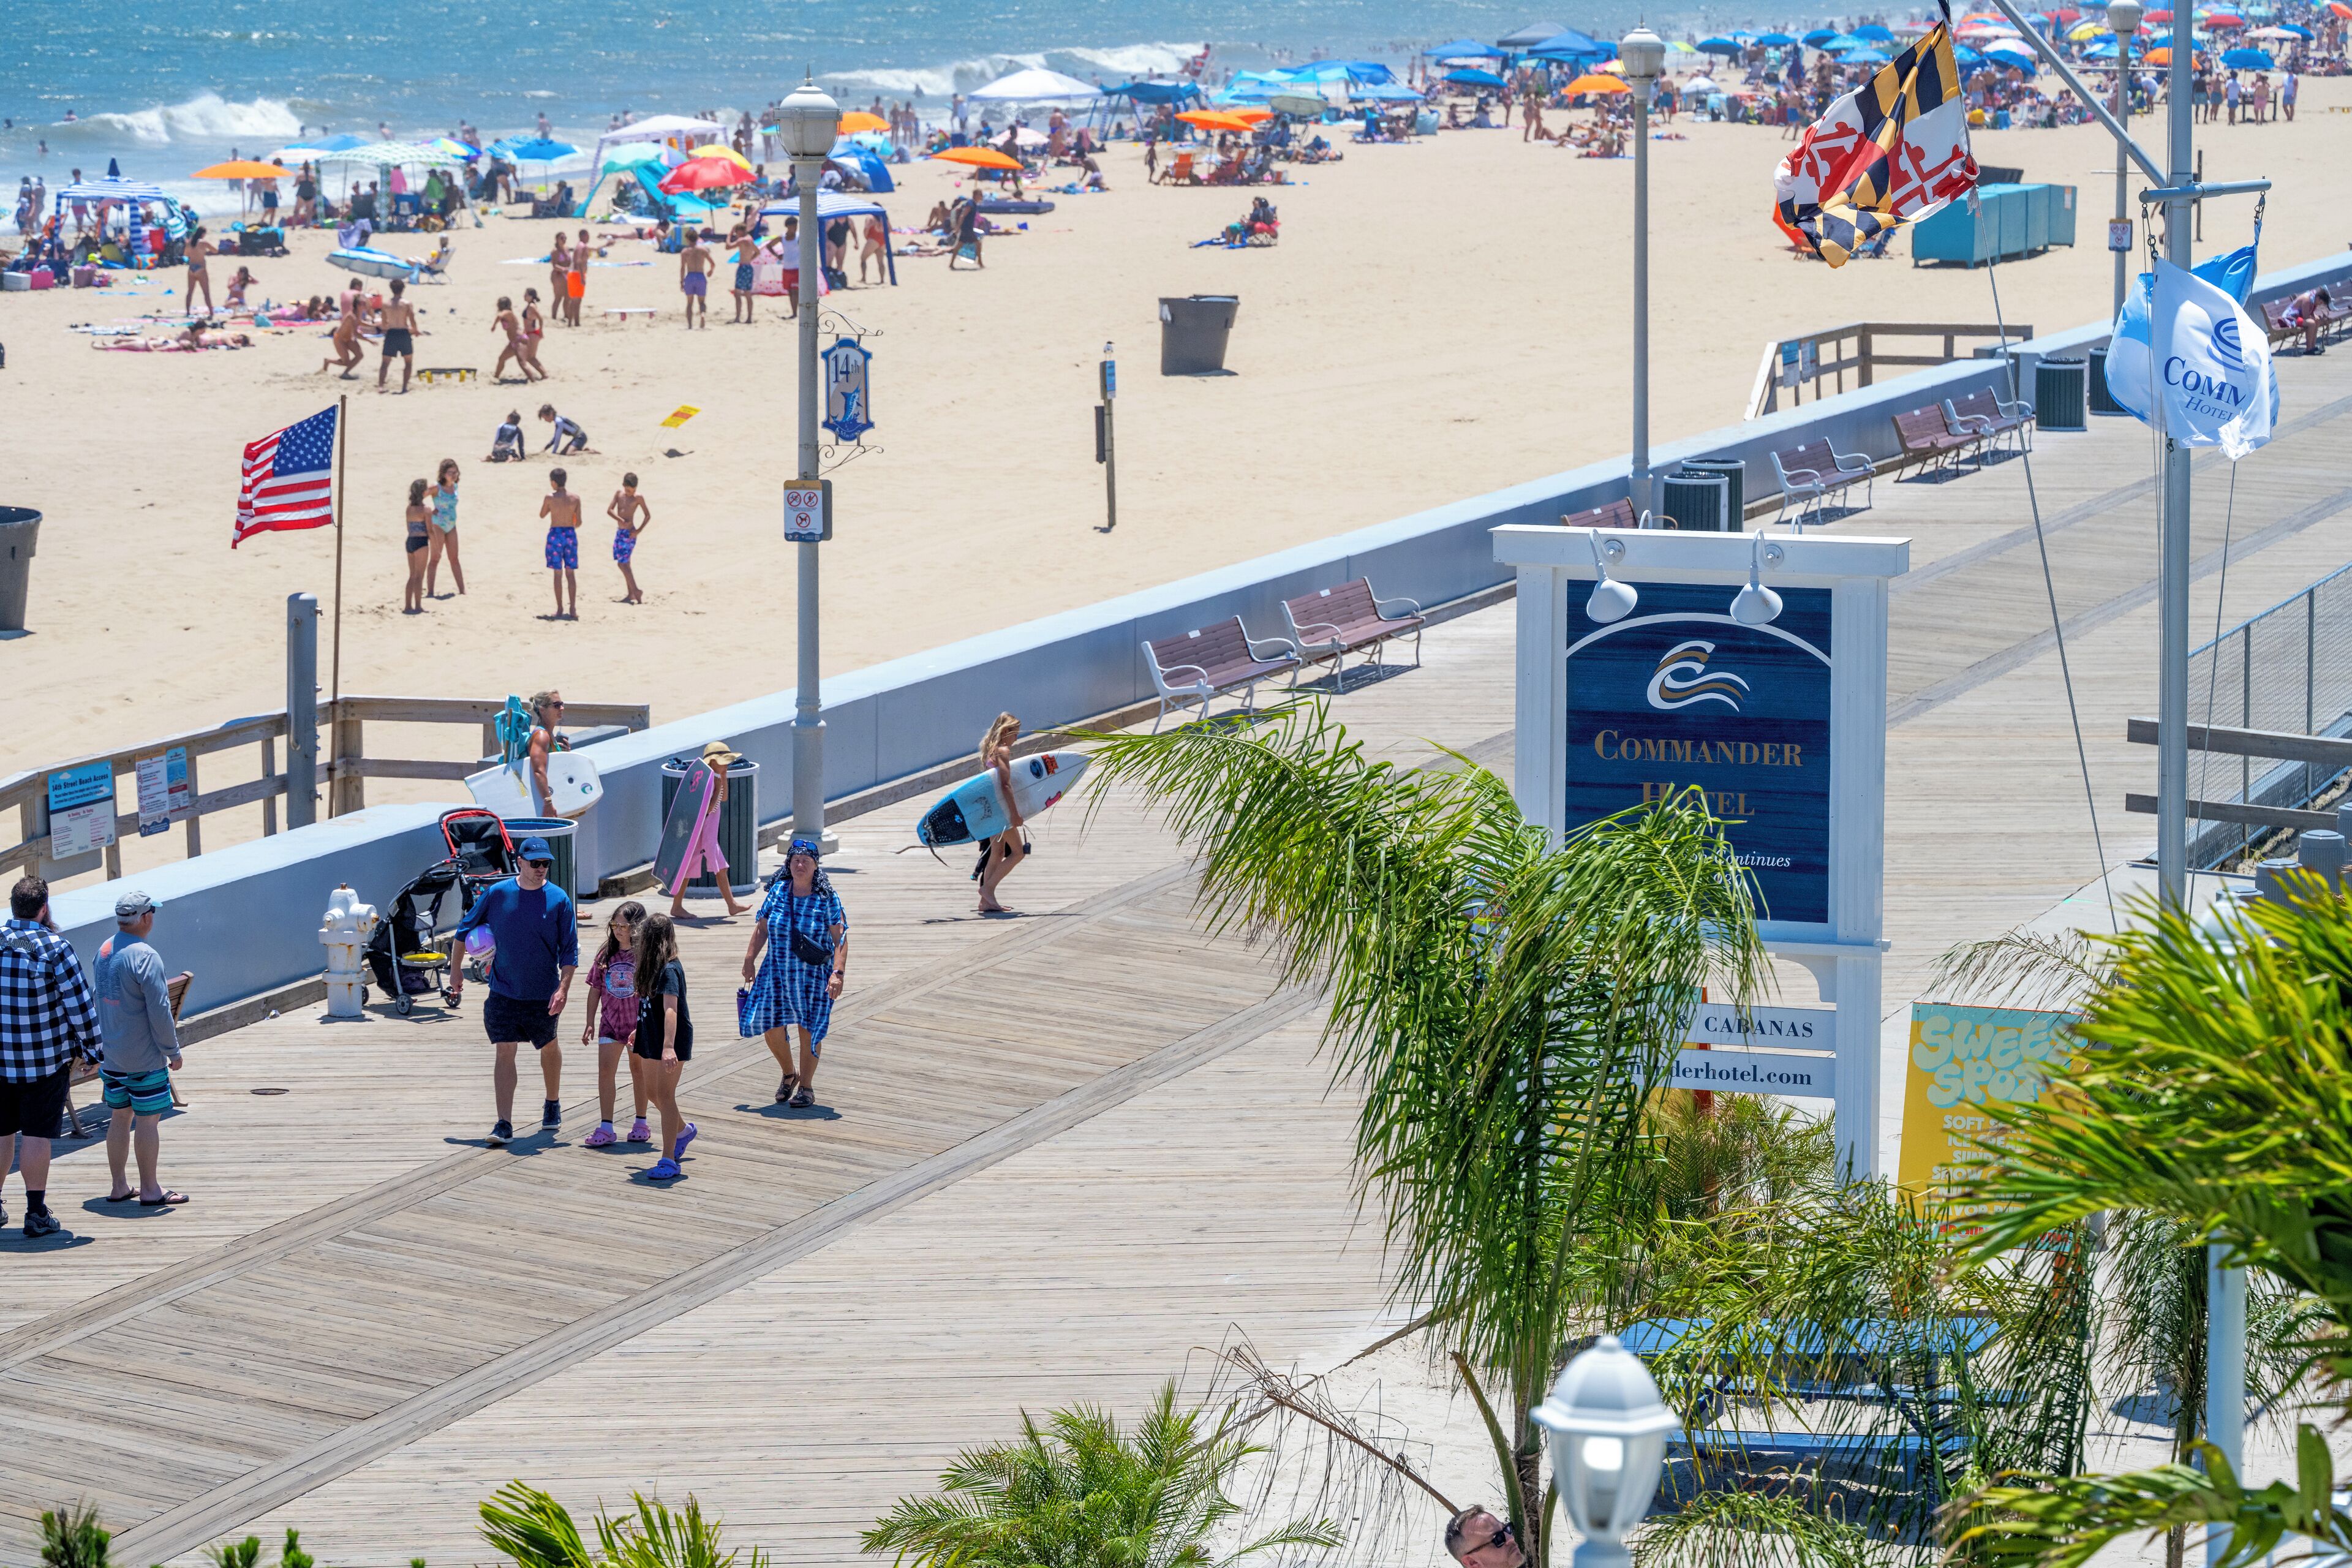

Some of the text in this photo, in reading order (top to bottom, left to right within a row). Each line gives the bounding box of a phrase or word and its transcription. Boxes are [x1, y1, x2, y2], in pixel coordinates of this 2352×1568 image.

[832, 353, 860, 383] 14th
[1594, 729, 1804, 767] COMMANDER
[64, 780, 78, 790] Street
[78, 775, 92, 785] Beach
[1714, 848, 1790, 867] Continues
[1713, 873, 1743, 889] 930
[1675, 1014, 1690, 1030] &
[1705, 1016, 1813, 1038] CABANAS
[1912, 1015, 2088, 1071] SWEET
[1927, 1059, 2053, 1105] SPOT
[1943, 1115, 1985, 1131] SOFT
[1948, 1133, 1971, 1148] ICE
[1931, 1166, 1983, 1182] SNOW
